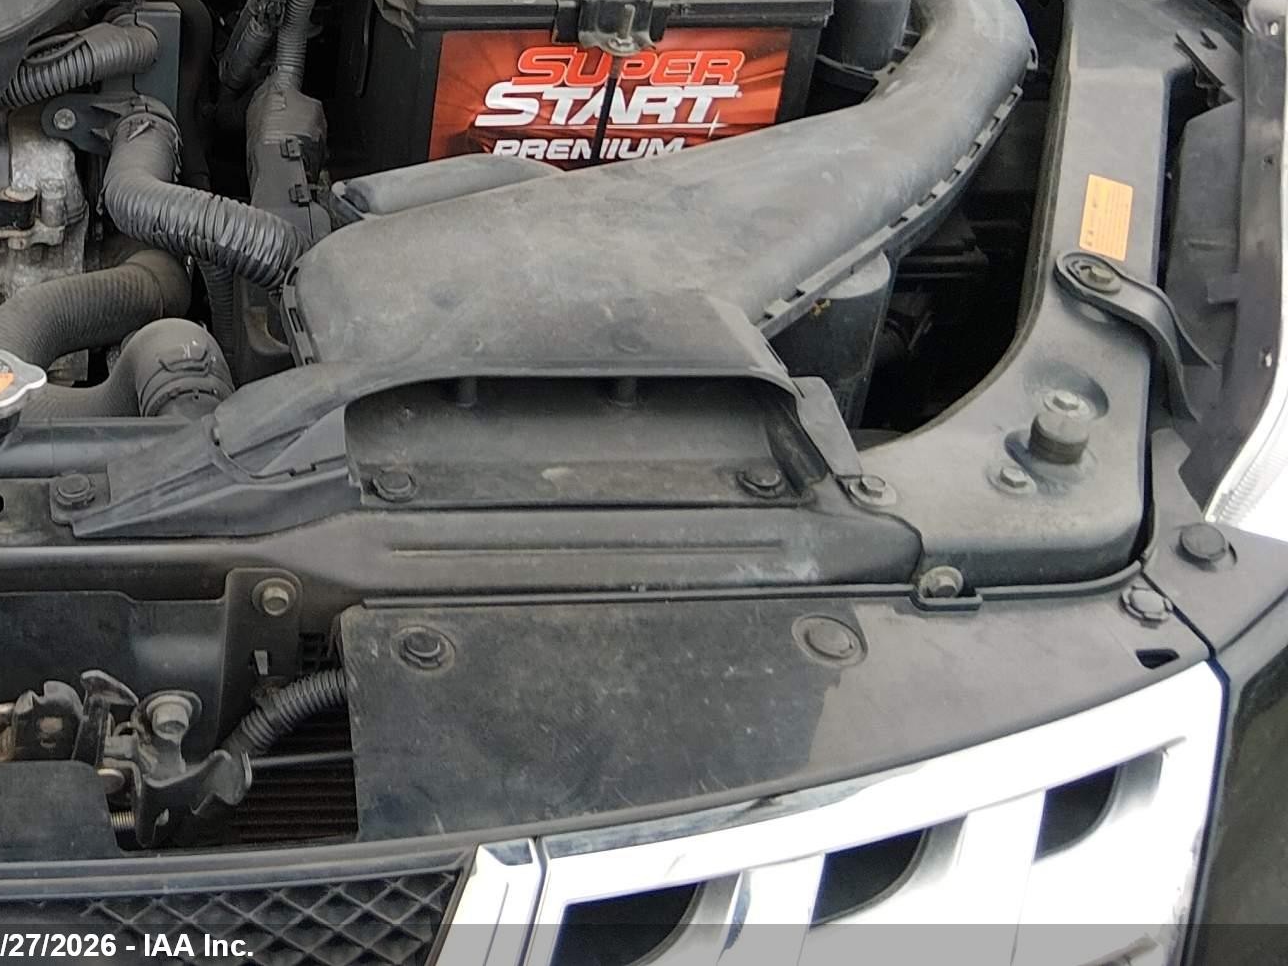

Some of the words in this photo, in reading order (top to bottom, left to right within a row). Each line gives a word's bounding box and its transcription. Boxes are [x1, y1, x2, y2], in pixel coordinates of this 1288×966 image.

[511, 47, 746, 86] SUPER
[474, 82, 740, 127] START
[491, 138, 686, 161] PREMIUM
